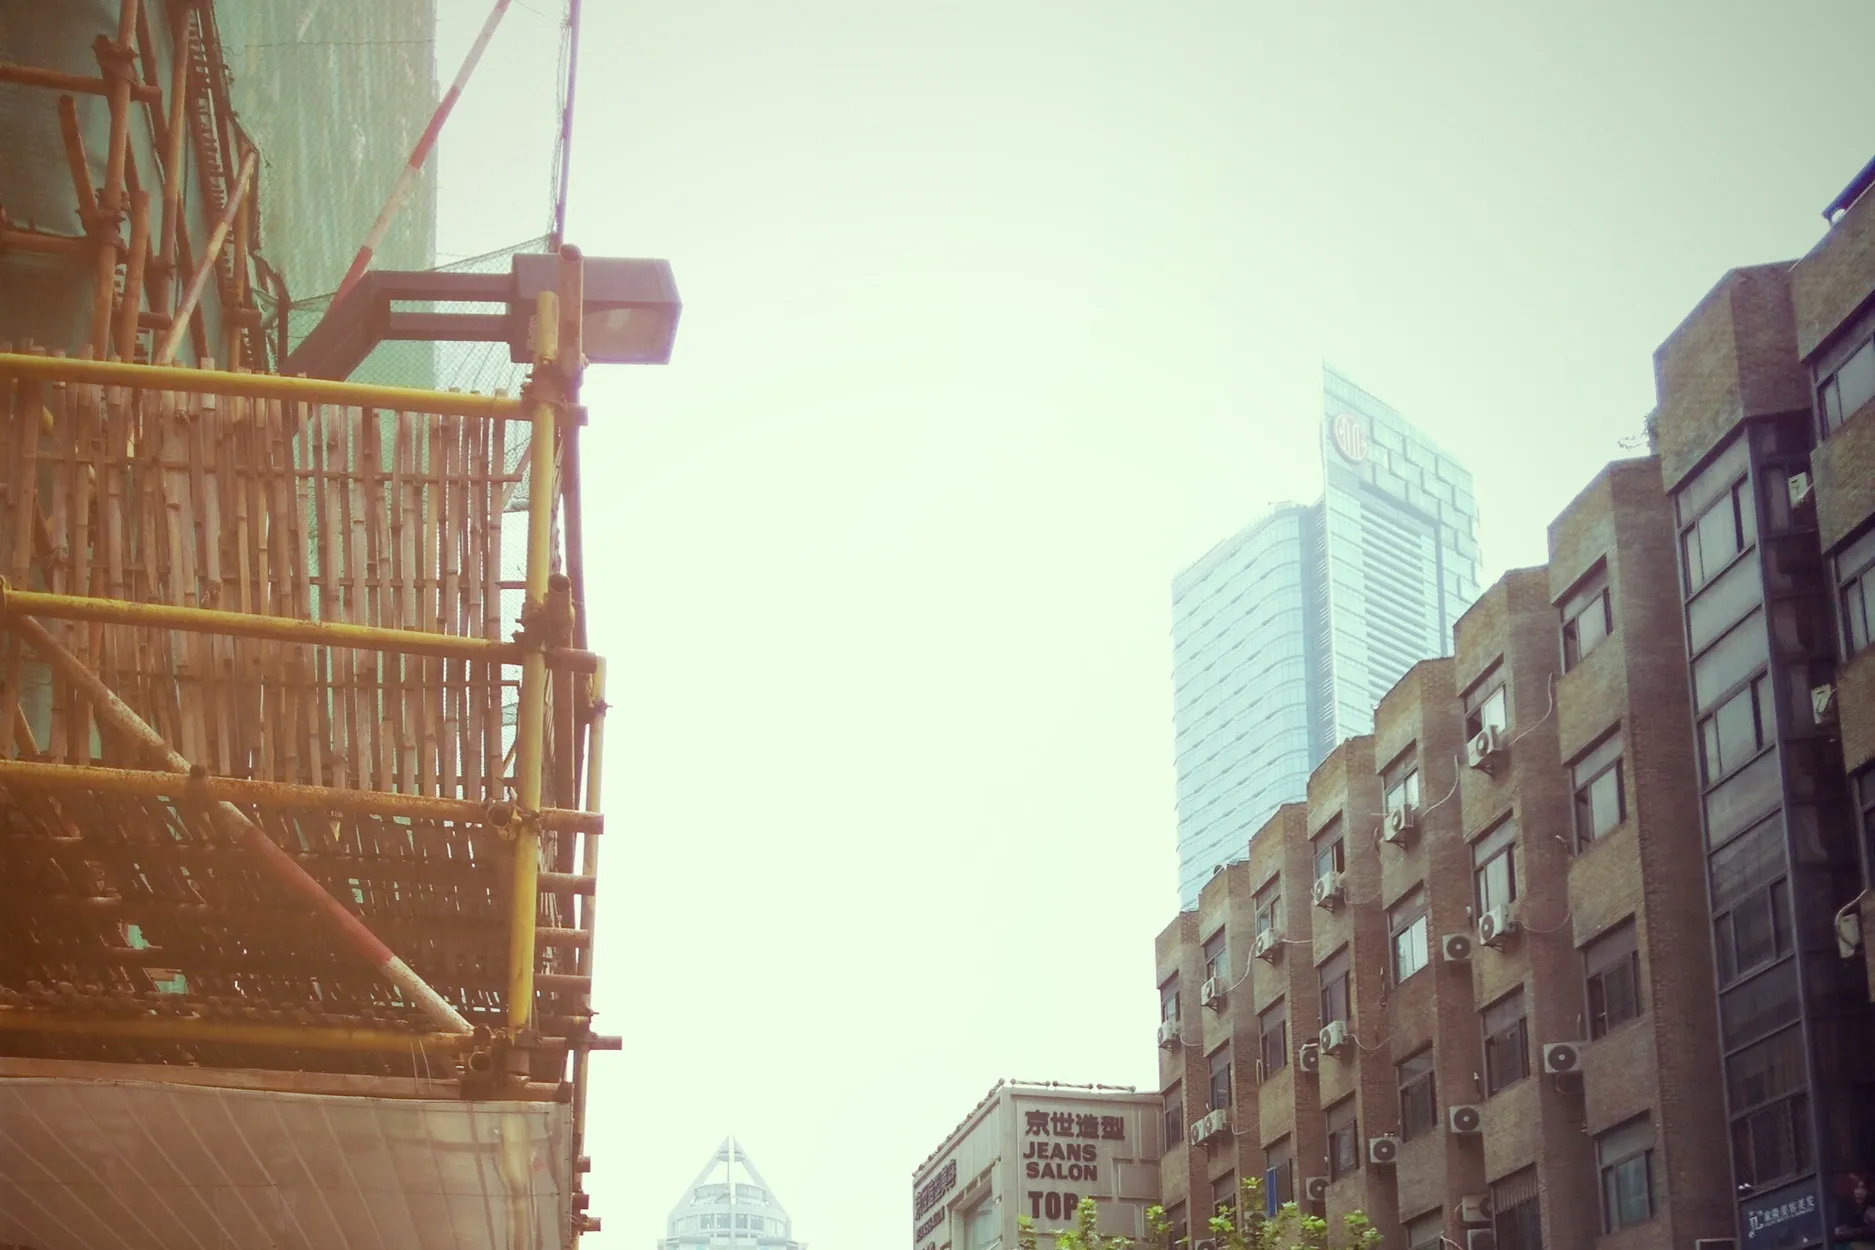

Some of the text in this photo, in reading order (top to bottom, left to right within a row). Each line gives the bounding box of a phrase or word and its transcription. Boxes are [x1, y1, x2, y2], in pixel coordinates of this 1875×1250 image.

[1024, 1110, 1126, 1140] 京世造型
[1023, 1141, 1098, 1162] JEANS
[1025, 1161, 1099, 1181] SALON
[1027, 1190, 1079, 1221] TOP
